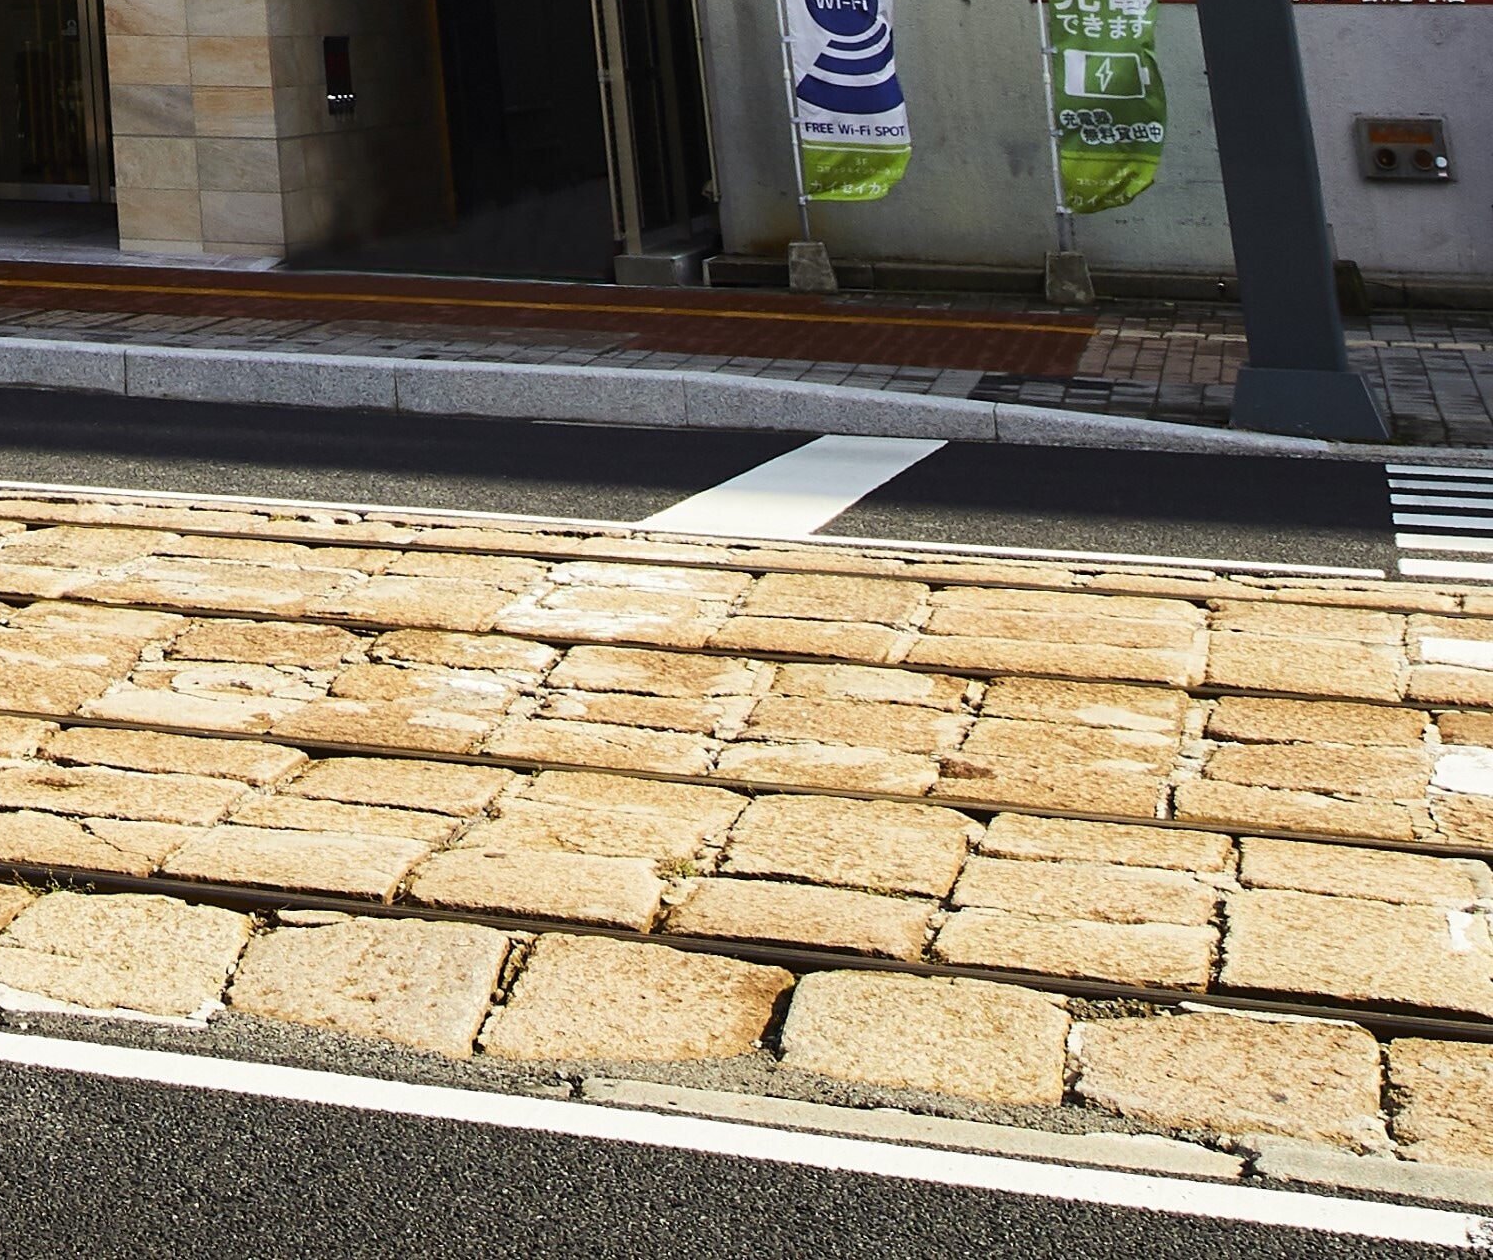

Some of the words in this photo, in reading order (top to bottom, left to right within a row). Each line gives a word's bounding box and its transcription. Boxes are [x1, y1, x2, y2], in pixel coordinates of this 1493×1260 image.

[1055, 13, 1153, 39] できます
[804, 122, 835, 134] FREE
[837, 123, 871, 136] Wi-Fi
[874, 126, 905, 137] SPOT
